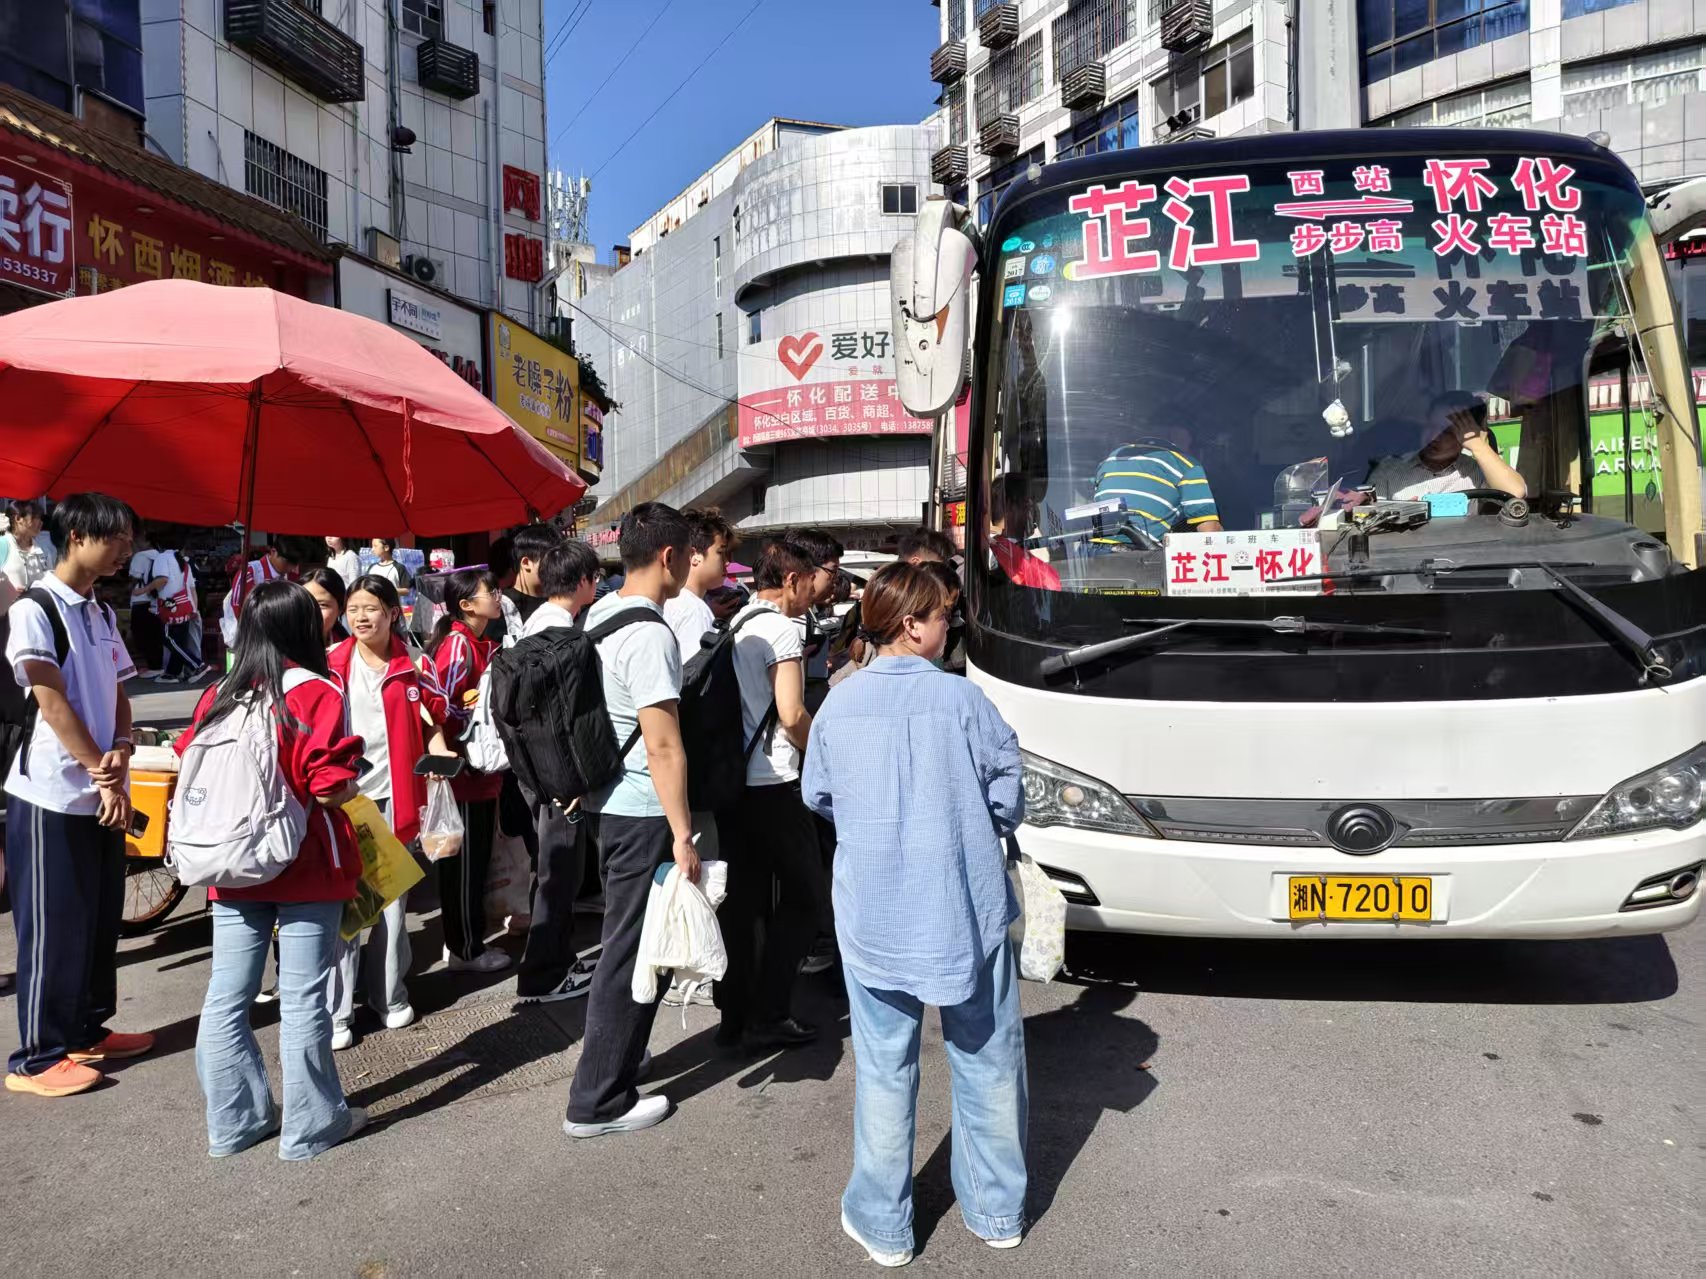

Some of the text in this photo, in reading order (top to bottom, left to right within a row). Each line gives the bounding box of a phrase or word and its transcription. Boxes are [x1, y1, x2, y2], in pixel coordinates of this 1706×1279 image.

[1288, 165, 1391, 196] 西站
[1424, 157, 1582, 213] 怀化
[1069, 174, 1260, 281] 芷江
[1290, 219, 1403, 258] 步步高
[1432, 212, 1588, 258] 火车站
[0, 257, 58, 285] 535337
[831, 331, 895, 361] 爱好
